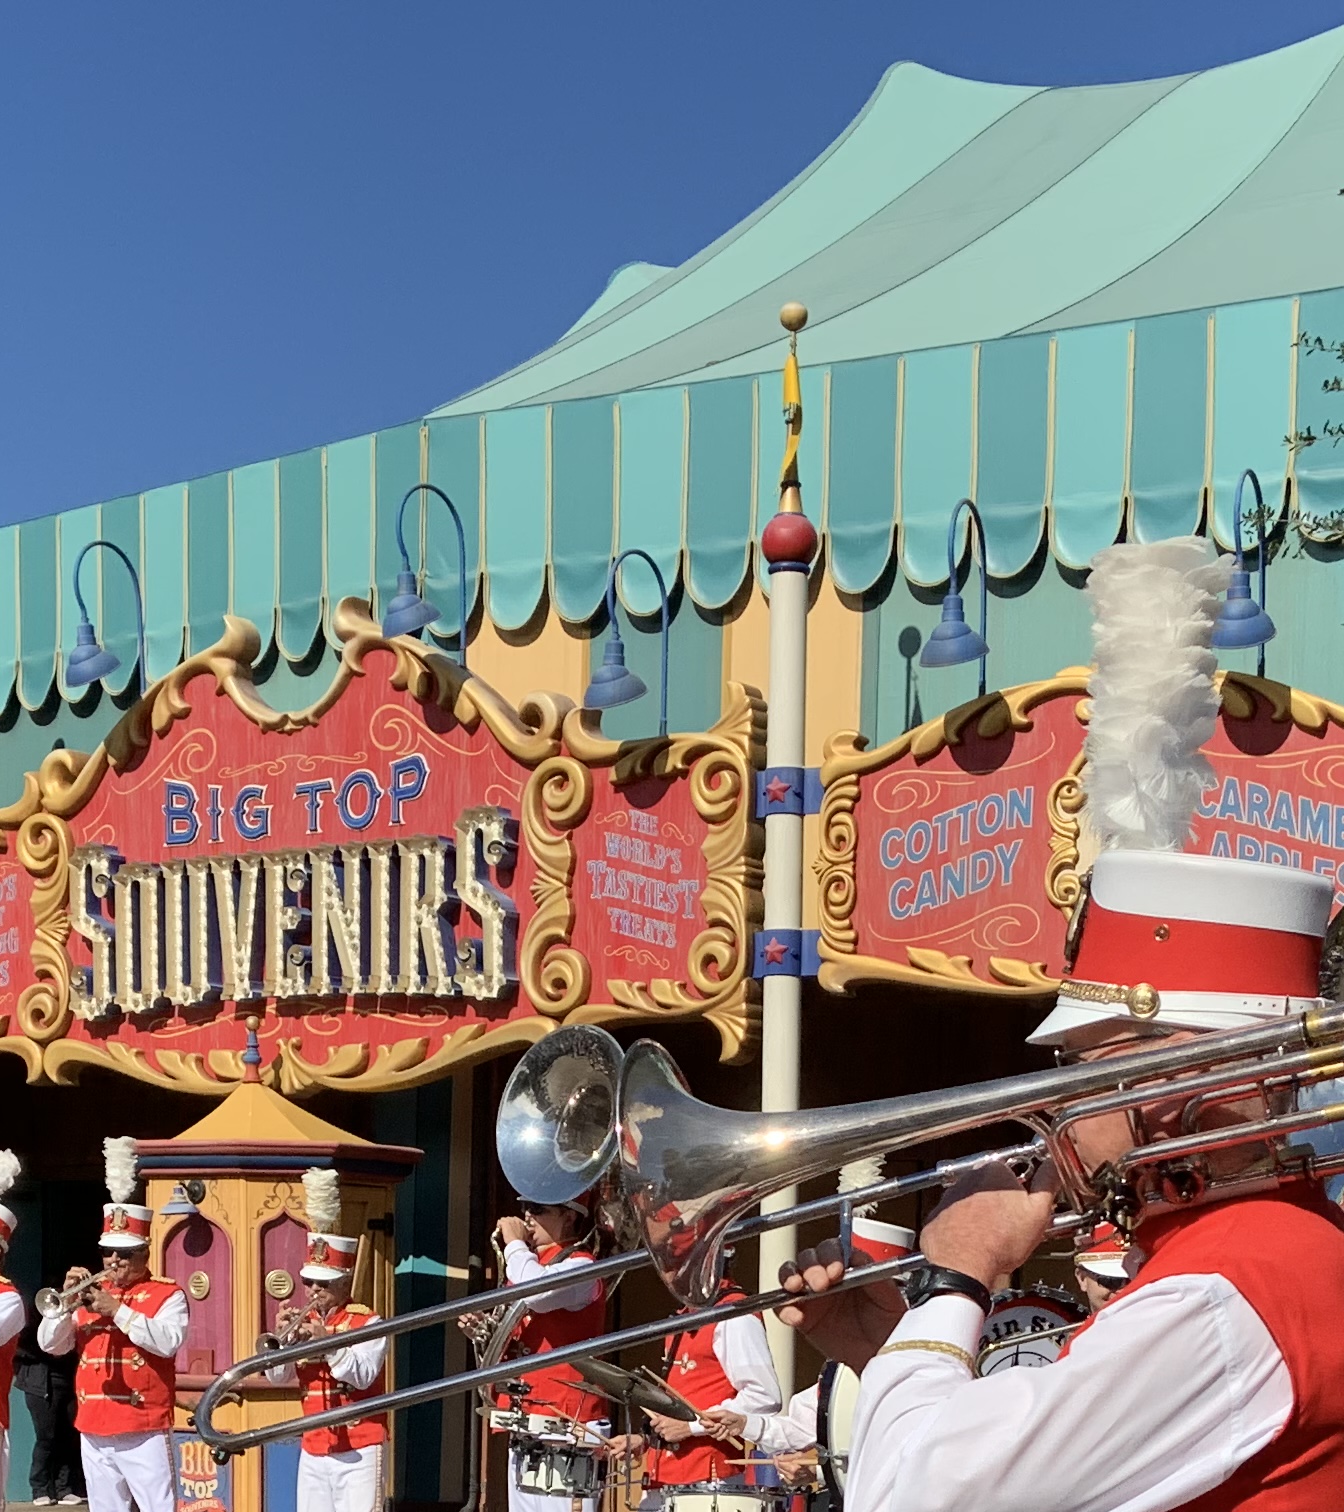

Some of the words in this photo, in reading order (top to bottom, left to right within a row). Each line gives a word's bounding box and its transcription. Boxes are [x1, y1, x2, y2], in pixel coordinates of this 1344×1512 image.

[162, 776, 273, 848] BIG
[295, 752, 430, 835] TOP
[629, 809, 659, 837] THE
[879, 785, 1034, 870] COTTON
[604, 831, 682, 875] WORLD'S
[888, 839, 1024, 921] CANDY
[68, 805, 520, 1021] SOUVENIRS
[586, 860, 700, 920] TASTIEST
[607, 907, 677, 949] TREATS
[180, 1476, 218, 1499] TOP
